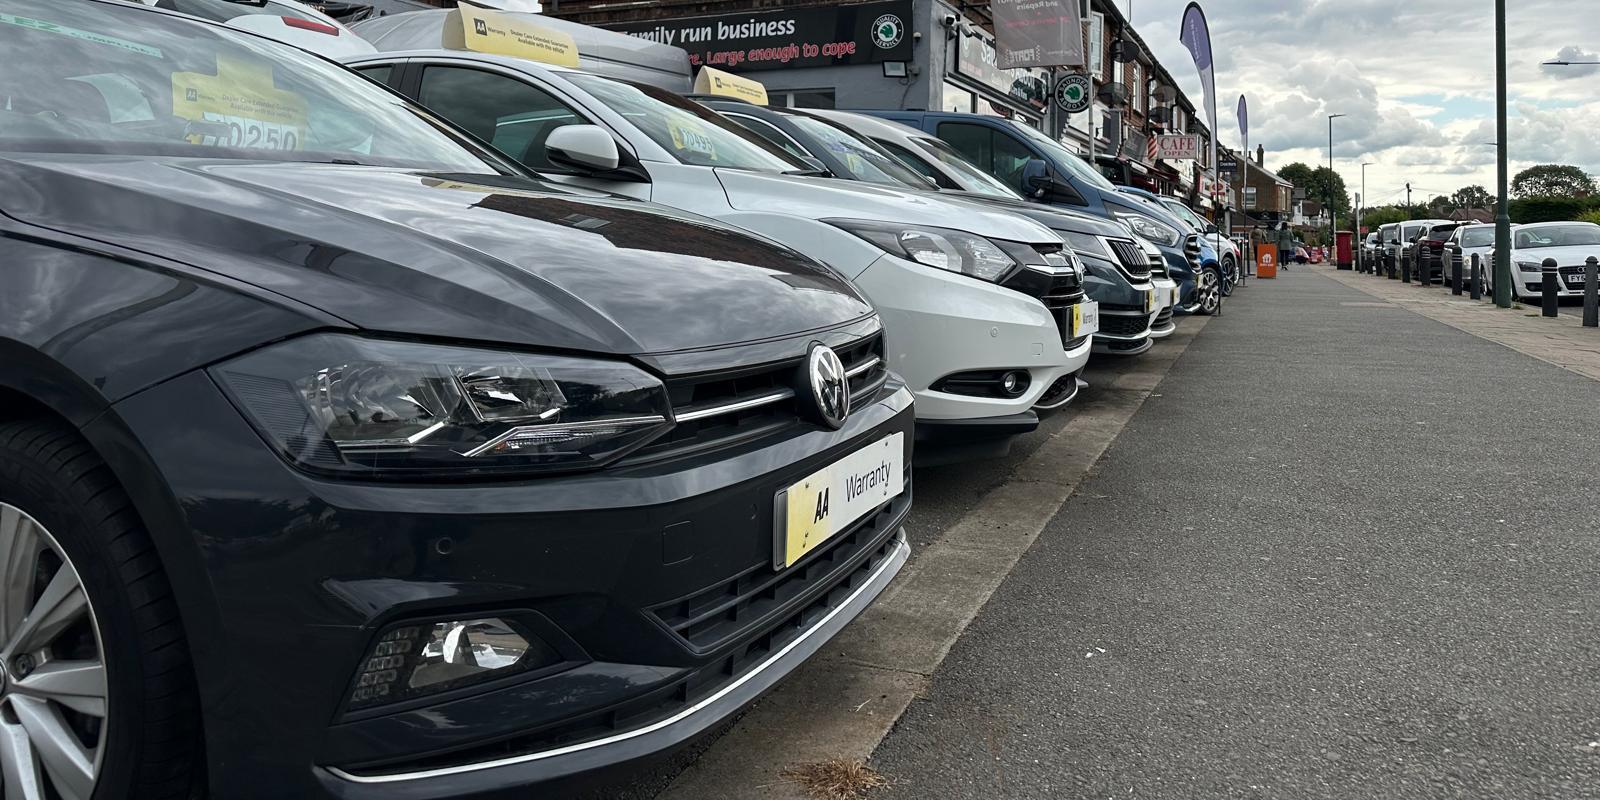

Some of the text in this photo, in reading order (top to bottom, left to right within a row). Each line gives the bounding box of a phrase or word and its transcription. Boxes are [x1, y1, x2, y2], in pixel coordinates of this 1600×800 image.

[876, 16, 899, 26] QUALITY
[681, 26, 712, 43] run
[717, 19, 795, 41] business
[876, 38, 899, 47] SERVICE
[707, 50, 745, 66] Large
[748, 43, 799, 62] enough
[803, 43, 818, 57] to
[822, 41, 856, 58] cope
[1160, 137, 1195, 150] CAFE
[814, 460, 892, 525] AA Warranty
